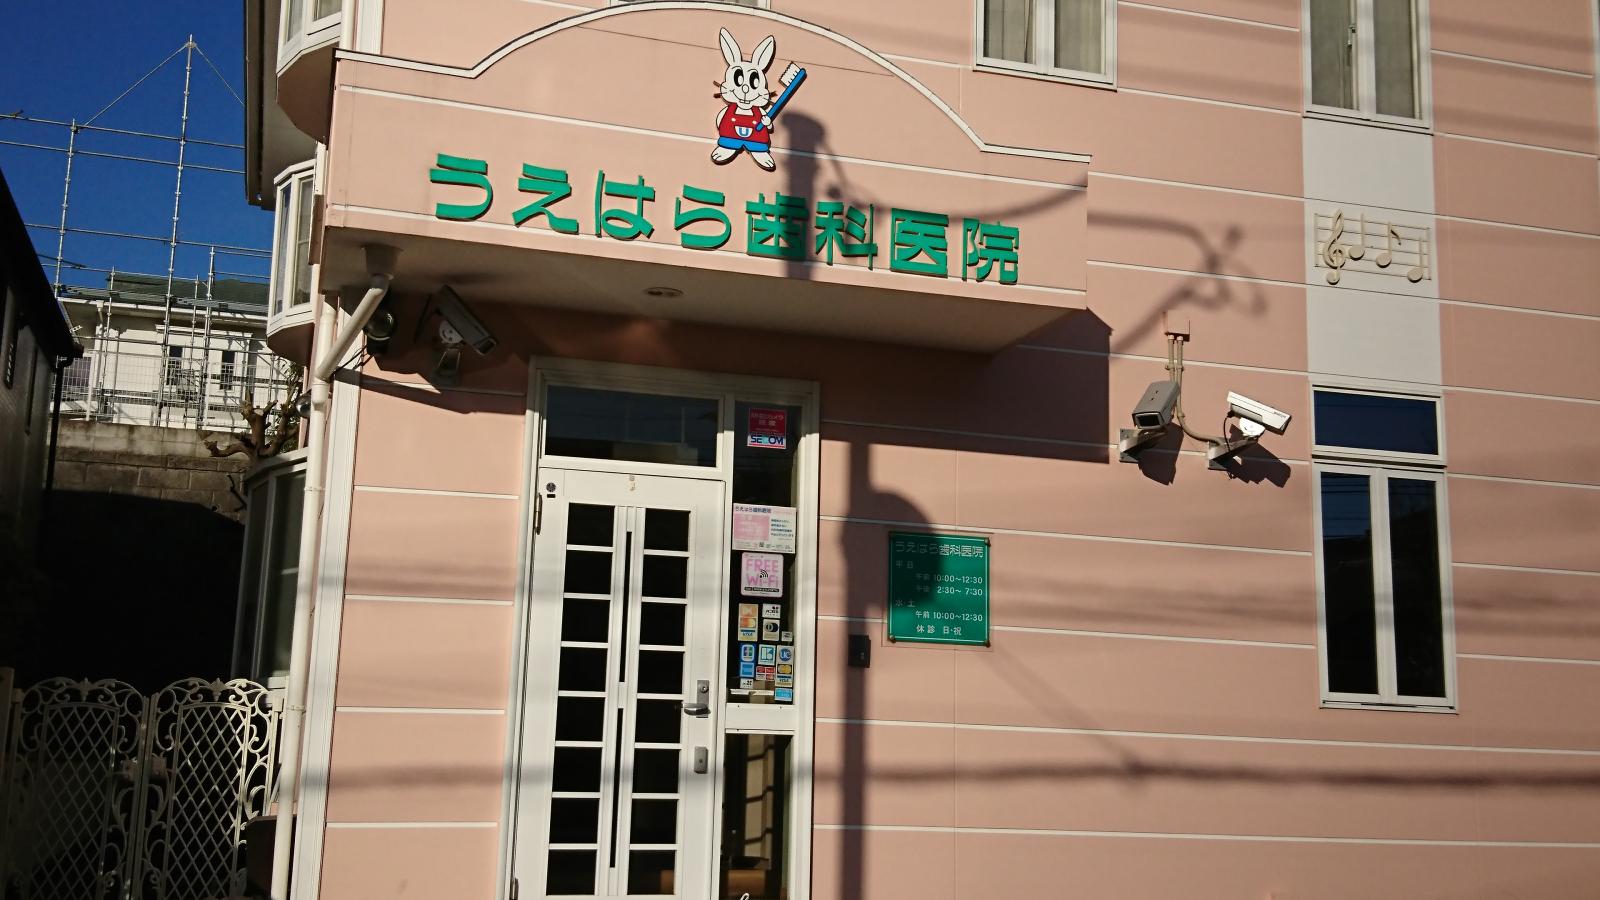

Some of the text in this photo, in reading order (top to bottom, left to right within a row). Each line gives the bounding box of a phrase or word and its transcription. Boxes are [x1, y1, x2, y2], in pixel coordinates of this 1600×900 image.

[738, 127, 749, 136] U
[429, 152, 1021, 285] うえはら歯科医院
[895, 541, 984, 558] うえはら歯科医院
[746, 559, 779, 573] FREE
[916, 610, 930, 619] 午前
[916, 624, 936, 634] 休診
